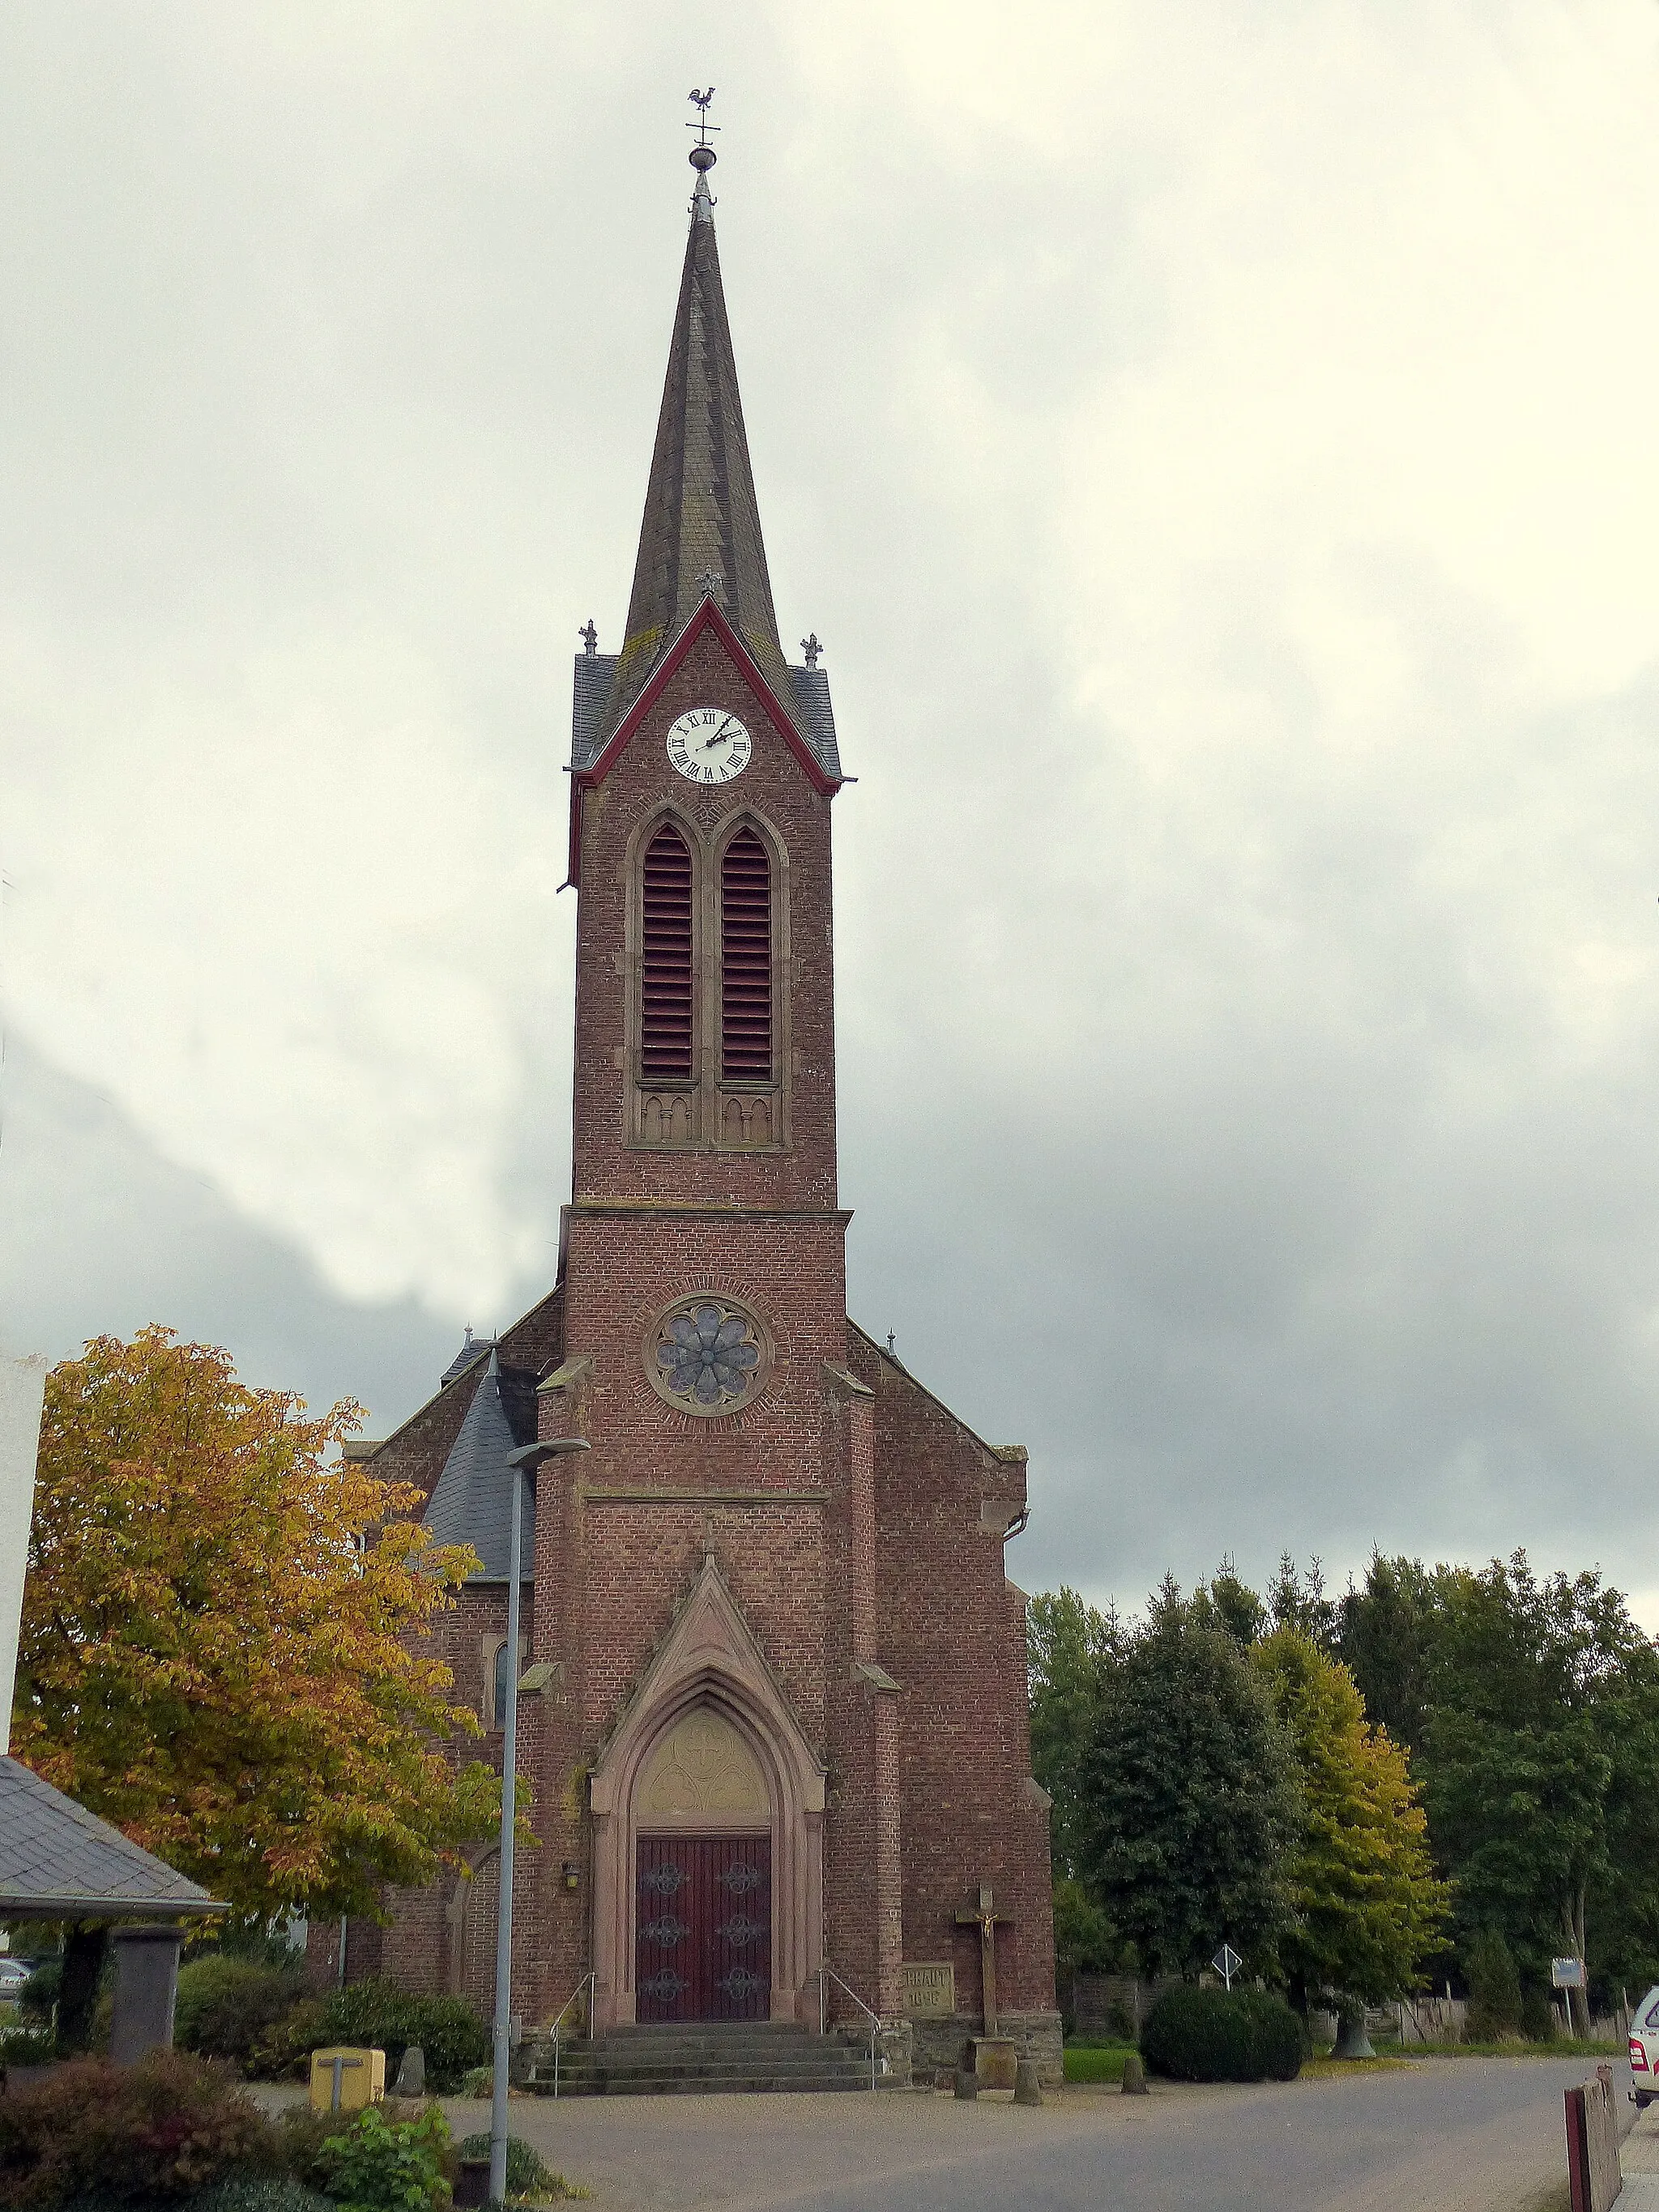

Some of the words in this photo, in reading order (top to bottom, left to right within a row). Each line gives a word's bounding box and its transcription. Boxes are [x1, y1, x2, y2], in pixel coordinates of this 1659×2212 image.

[686, 715, 701, 728] XI
[702, 713, 715, 725] XII
[676, 726, 690, 735] X
[672, 738, 685, 748] IX
[733, 742, 746, 752] III
[673, 749, 691, 768] VIII
[726, 753, 744, 769] IIII
[685, 761, 701, 778] VII
[704, 767, 714, 779] VI
[719, 765, 730, 777] V
